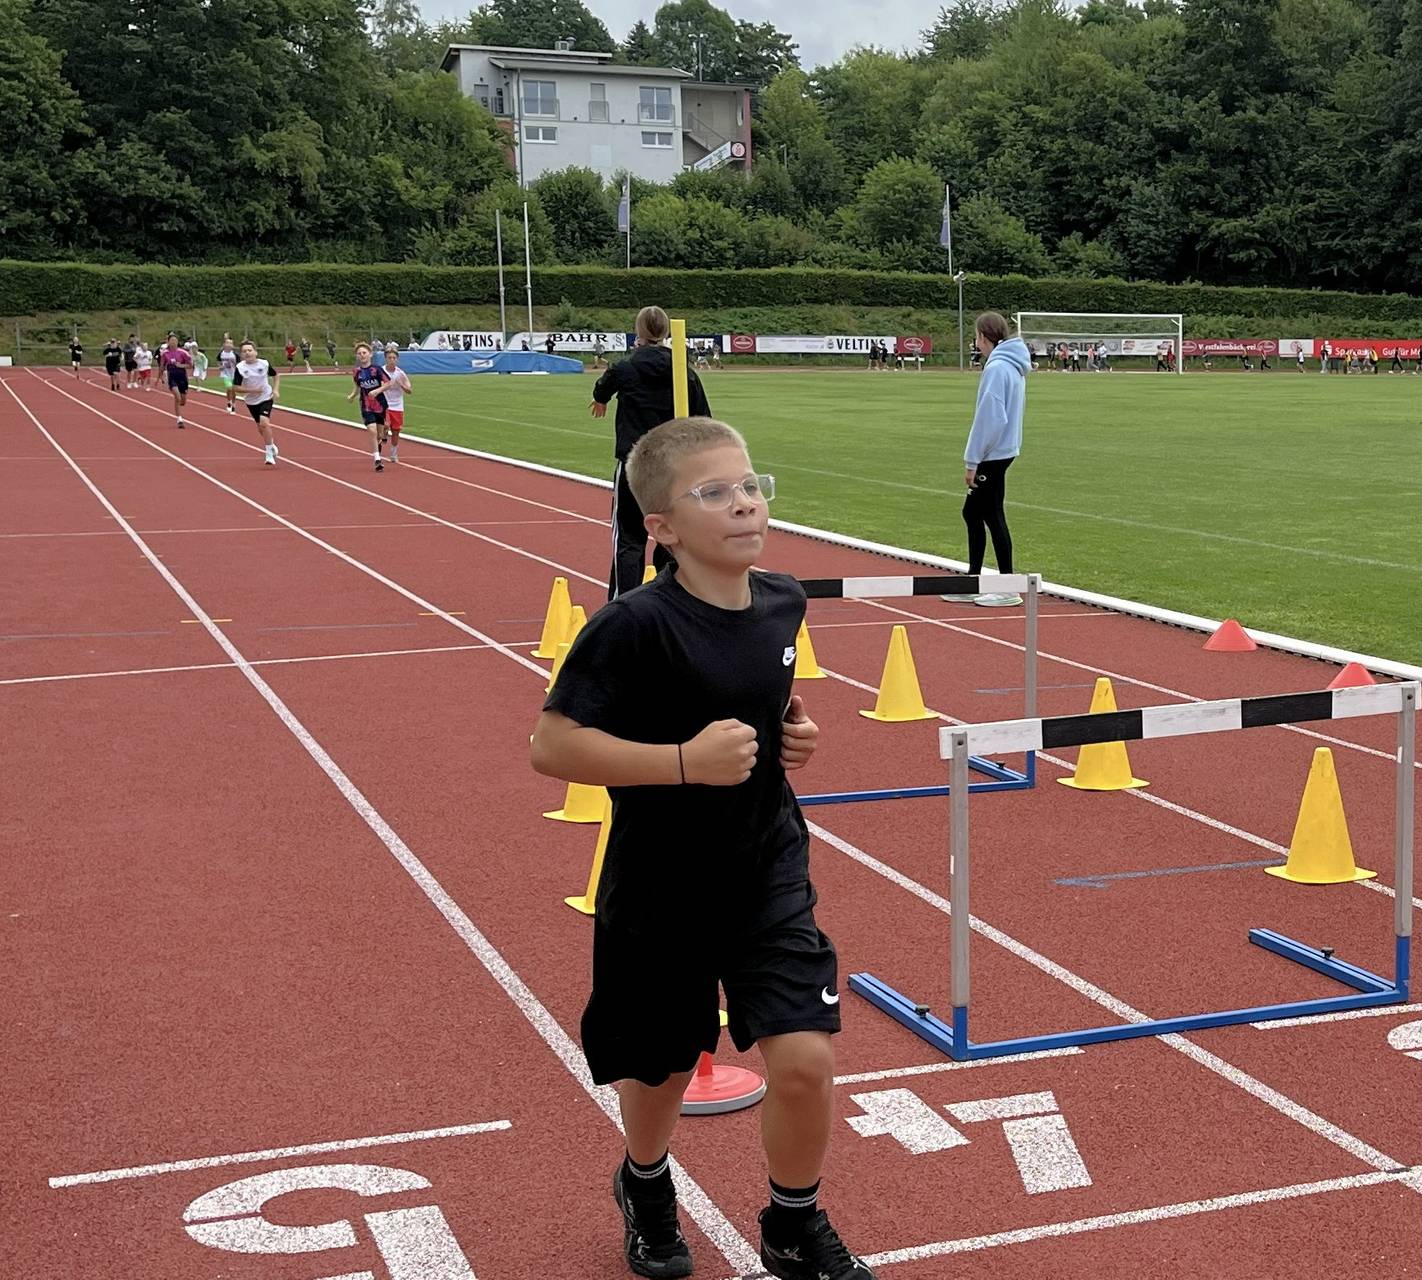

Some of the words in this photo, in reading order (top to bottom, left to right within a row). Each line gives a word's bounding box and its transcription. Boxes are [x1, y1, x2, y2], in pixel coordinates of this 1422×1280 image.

[552, 333, 608, 343] BAHR
[836, 338, 885, 350] VELTINS
[844, 1087, 1095, 1195] 4
[182, 1163, 478, 1280] 5
